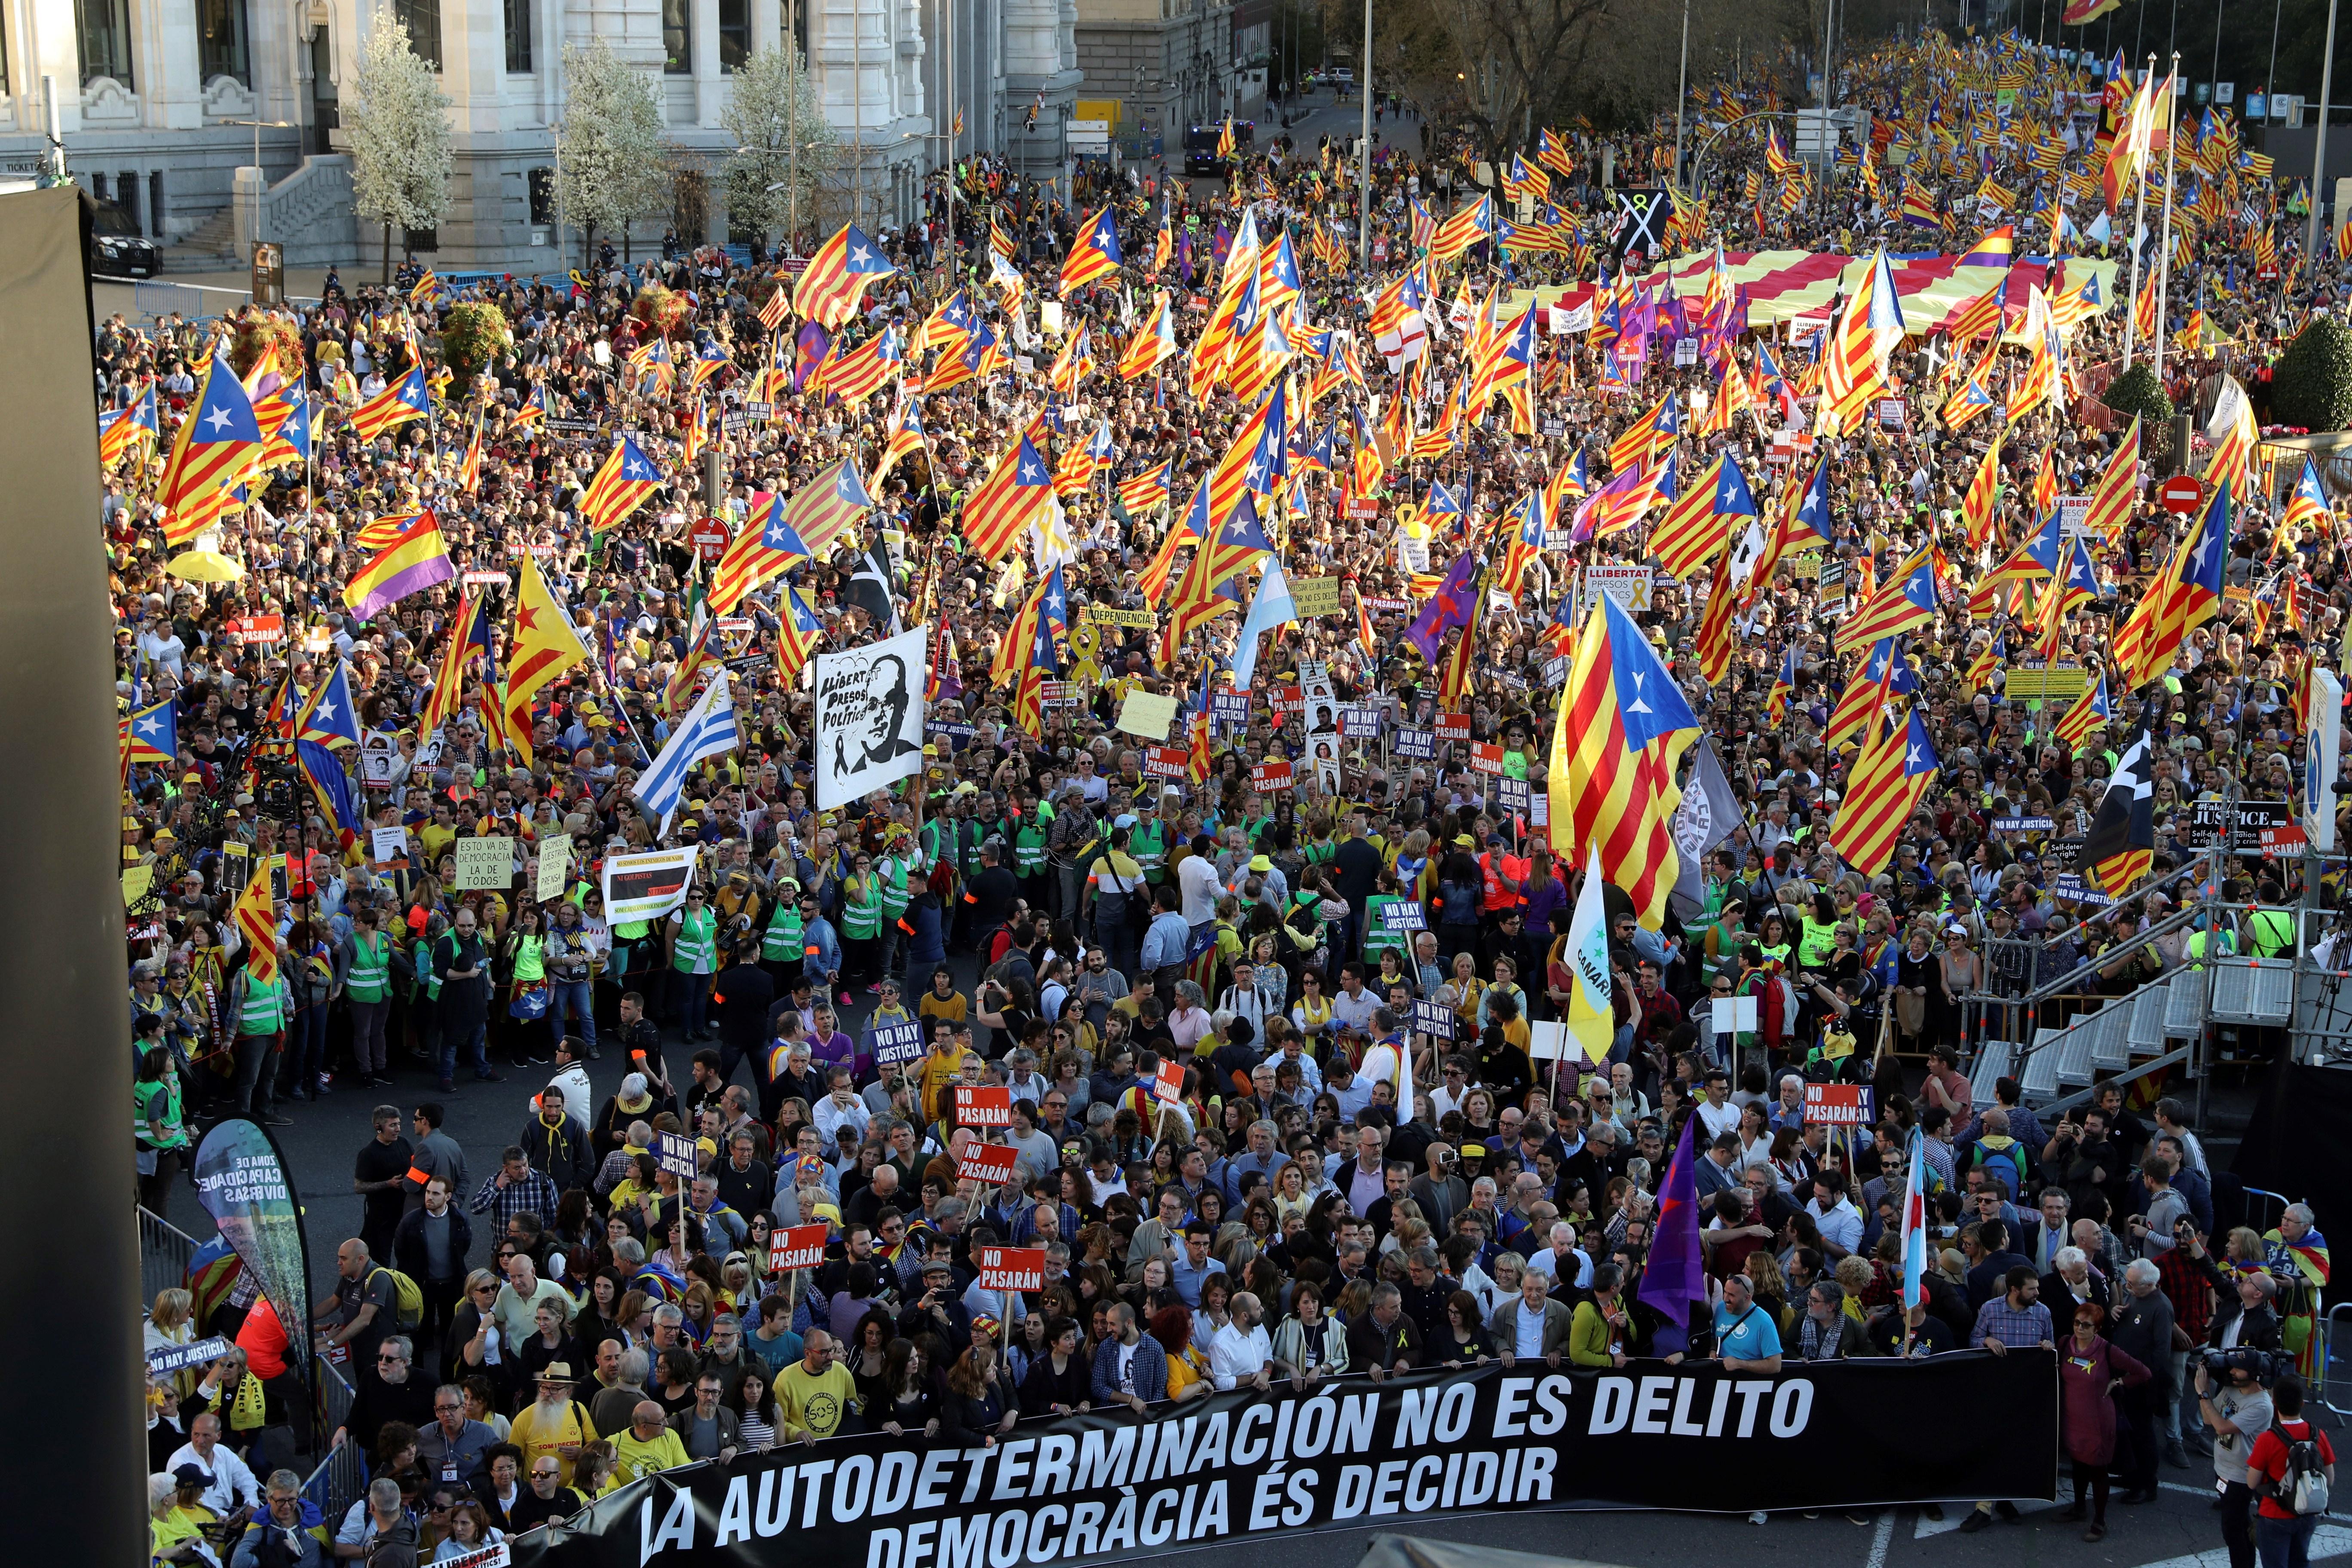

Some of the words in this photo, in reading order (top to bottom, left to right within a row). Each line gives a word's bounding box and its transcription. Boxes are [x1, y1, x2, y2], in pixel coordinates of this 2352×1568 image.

[732, 411, 743, 420] HAY
[748, 410, 769, 419] JUSTÍCIA
[725, 420, 745, 429] JUSTÍCIA
[1545, 420, 1552, 428] NO
[1553, 420, 1563, 429] HAY
[1543, 428, 1562, 436] JUSTÍCIA
[1727, 444, 1739, 453] HAY
[1766, 446, 1773, 454] NO
[1765, 453, 1790, 462] PASARÁN
[1350, 500, 1357, 508] NO
[1350, 508, 1376, 518] PASARÁN
[1546, 531, 1555, 541] NO
[1556, 530, 1568, 540] HAY
[464, 573, 474, 582] NO
[475, 573, 507, 582] PASARÁN
[1589, 570, 1648, 578] LLIBERTAT
[1363, 597, 1372, 606] NO
[1372, 598, 1406, 610] PASARÁN
[1084, 608, 1151, 625] INDEPENDÈNCIA
[243, 619, 253, 629] NO
[243, 628, 279, 641] PASARÁN
[727, 654, 768, 667] L'AUTODETERMINACIÓ
[1546, 663, 1553, 677] NO
[1553, 657, 1563, 672] HAY
[1547, 670, 1565, 688] JUSTÍCIA
[826, 689, 866, 710] PRESOS
[1273, 689, 1285, 700] NO
[1215, 696, 1228, 708] NO
[1229, 697, 1246, 708] HAY
[1347, 711, 1360, 723] NO
[1361, 710, 1378, 723] HAY
[1435, 714, 1445, 725] NO
[1344, 723, 1376, 736] JUSTÍCIA
[1436, 725, 1469, 739] PASARÁN
[1400, 730, 1413, 744] NO
[1415, 731, 1433, 746] HAY
[1149, 747, 1161, 759] NO
[1396, 743, 1430, 758] JUSTÍCIA
[1473, 742, 1482, 755] NO
[1147, 760, 1185, 778] PASARÁN
[1344, 763, 1358, 772] Bona
[1471, 755, 1502, 774] PASARÁN
[1253, 767, 1265, 779] NO
[1348, 770, 1363, 778] Oriol!
[1254, 774, 1292, 792] PASARÁN
[1500, 779, 1512, 793] NO
[1512, 779, 1527, 796] HAY
[1499, 793, 1528, 808] JUSTÍCIA
[1996, 820, 2005, 829] NO
[2006, 820, 2019, 828] HAY
[2021, 817, 2052, 828] JUSTÍCIA
[2260, 830, 2275, 843] NO
[460, 841, 482, 851] ESTO
[486, 841, 496, 850] VA
[498, 841, 508, 850] DE
[545, 838, 564, 851] SOMOS
[458, 851, 510, 863] DEMOCRACIA
[541, 848, 567, 861] VUESTROS
[542, 861, 560, 871] AMIGOS
[541, 875, 561, 887] PRENSA
[624, 873, 652, 881] GOLPISTAS
[2057, 888, 2067, 897] NO
[2068, 890, 2082, 900] HAY
[2084, 893, 2119, 906] JUSTÍCIA
[1384, 903, 1399, 917] NO
[1400, 902, 1420, 915] HAY
[1386, 912, 1424, 929] JUSTÍCIA
[205, 982, 220, 1030] PASARÁN
[1416, 1001, 1430, 1018] NO
[1431, 1005, 1450, 1023] HAY
[1416, 1017, 1450, 1038] JUSTÍCIA
[214, 1031, 220, 1045] NO
[875, 1029, 894, 1047] NO
[895, 1024, 919, 1044] HAY
[876, 1041, 923, 1063] JUSTÍCIA
[1158, 1060, 1167, 1078] NO
[956, 1089, 972, 1105] NO
[1154, 1078, 1180, 1103] PASARÁN
[1807, 1086, 1822, 1102] NO
[958, 1104, 1009, 1124] PASARÁN
[1806, 1102, 1856, 1122] PASARÁN
[662, 1134, 674, 1155] NO
[677, 1138, 694, 1161] HAY
[964, 1143, 982, 1160] NO
[661, 1154, 695, 1179] JUSTÍCIA
[958, 1160, 1011, 1182] PASARÁN
[773, 1231, 789, 1250] NO
[771, 1243, 823, 1269] PASARÁN
[983, 1249, 1001, 1267] NO
[981, 1267, 1041, 1289] PASARÁN
[149, 1356, 164, 1372] NO
[166, 1353, 184, 1368] HAY
[185, 1339, 228, 1362] JUSTÍCIA
[806, 1393, 838, 1407] ENSENYAMENT
[809, 1402, 834, 1421] SOS
[640, 1486, 695, 1568] LA
[714, 1377, 1380, 1548] AUTODETERMINACIÓN
[1393, 1380, 1477, 1449] NO
[1492, 1374, 1572, 1438] ES
[1588, 1375, 1814, 1438] DELITO
[866, 1479, 1229, 1568] DEMOCRÀCIA
[1248, 1460, 1318, 1531] ÉS
[1332, 1446, 1559, 1523] DECIDIR
